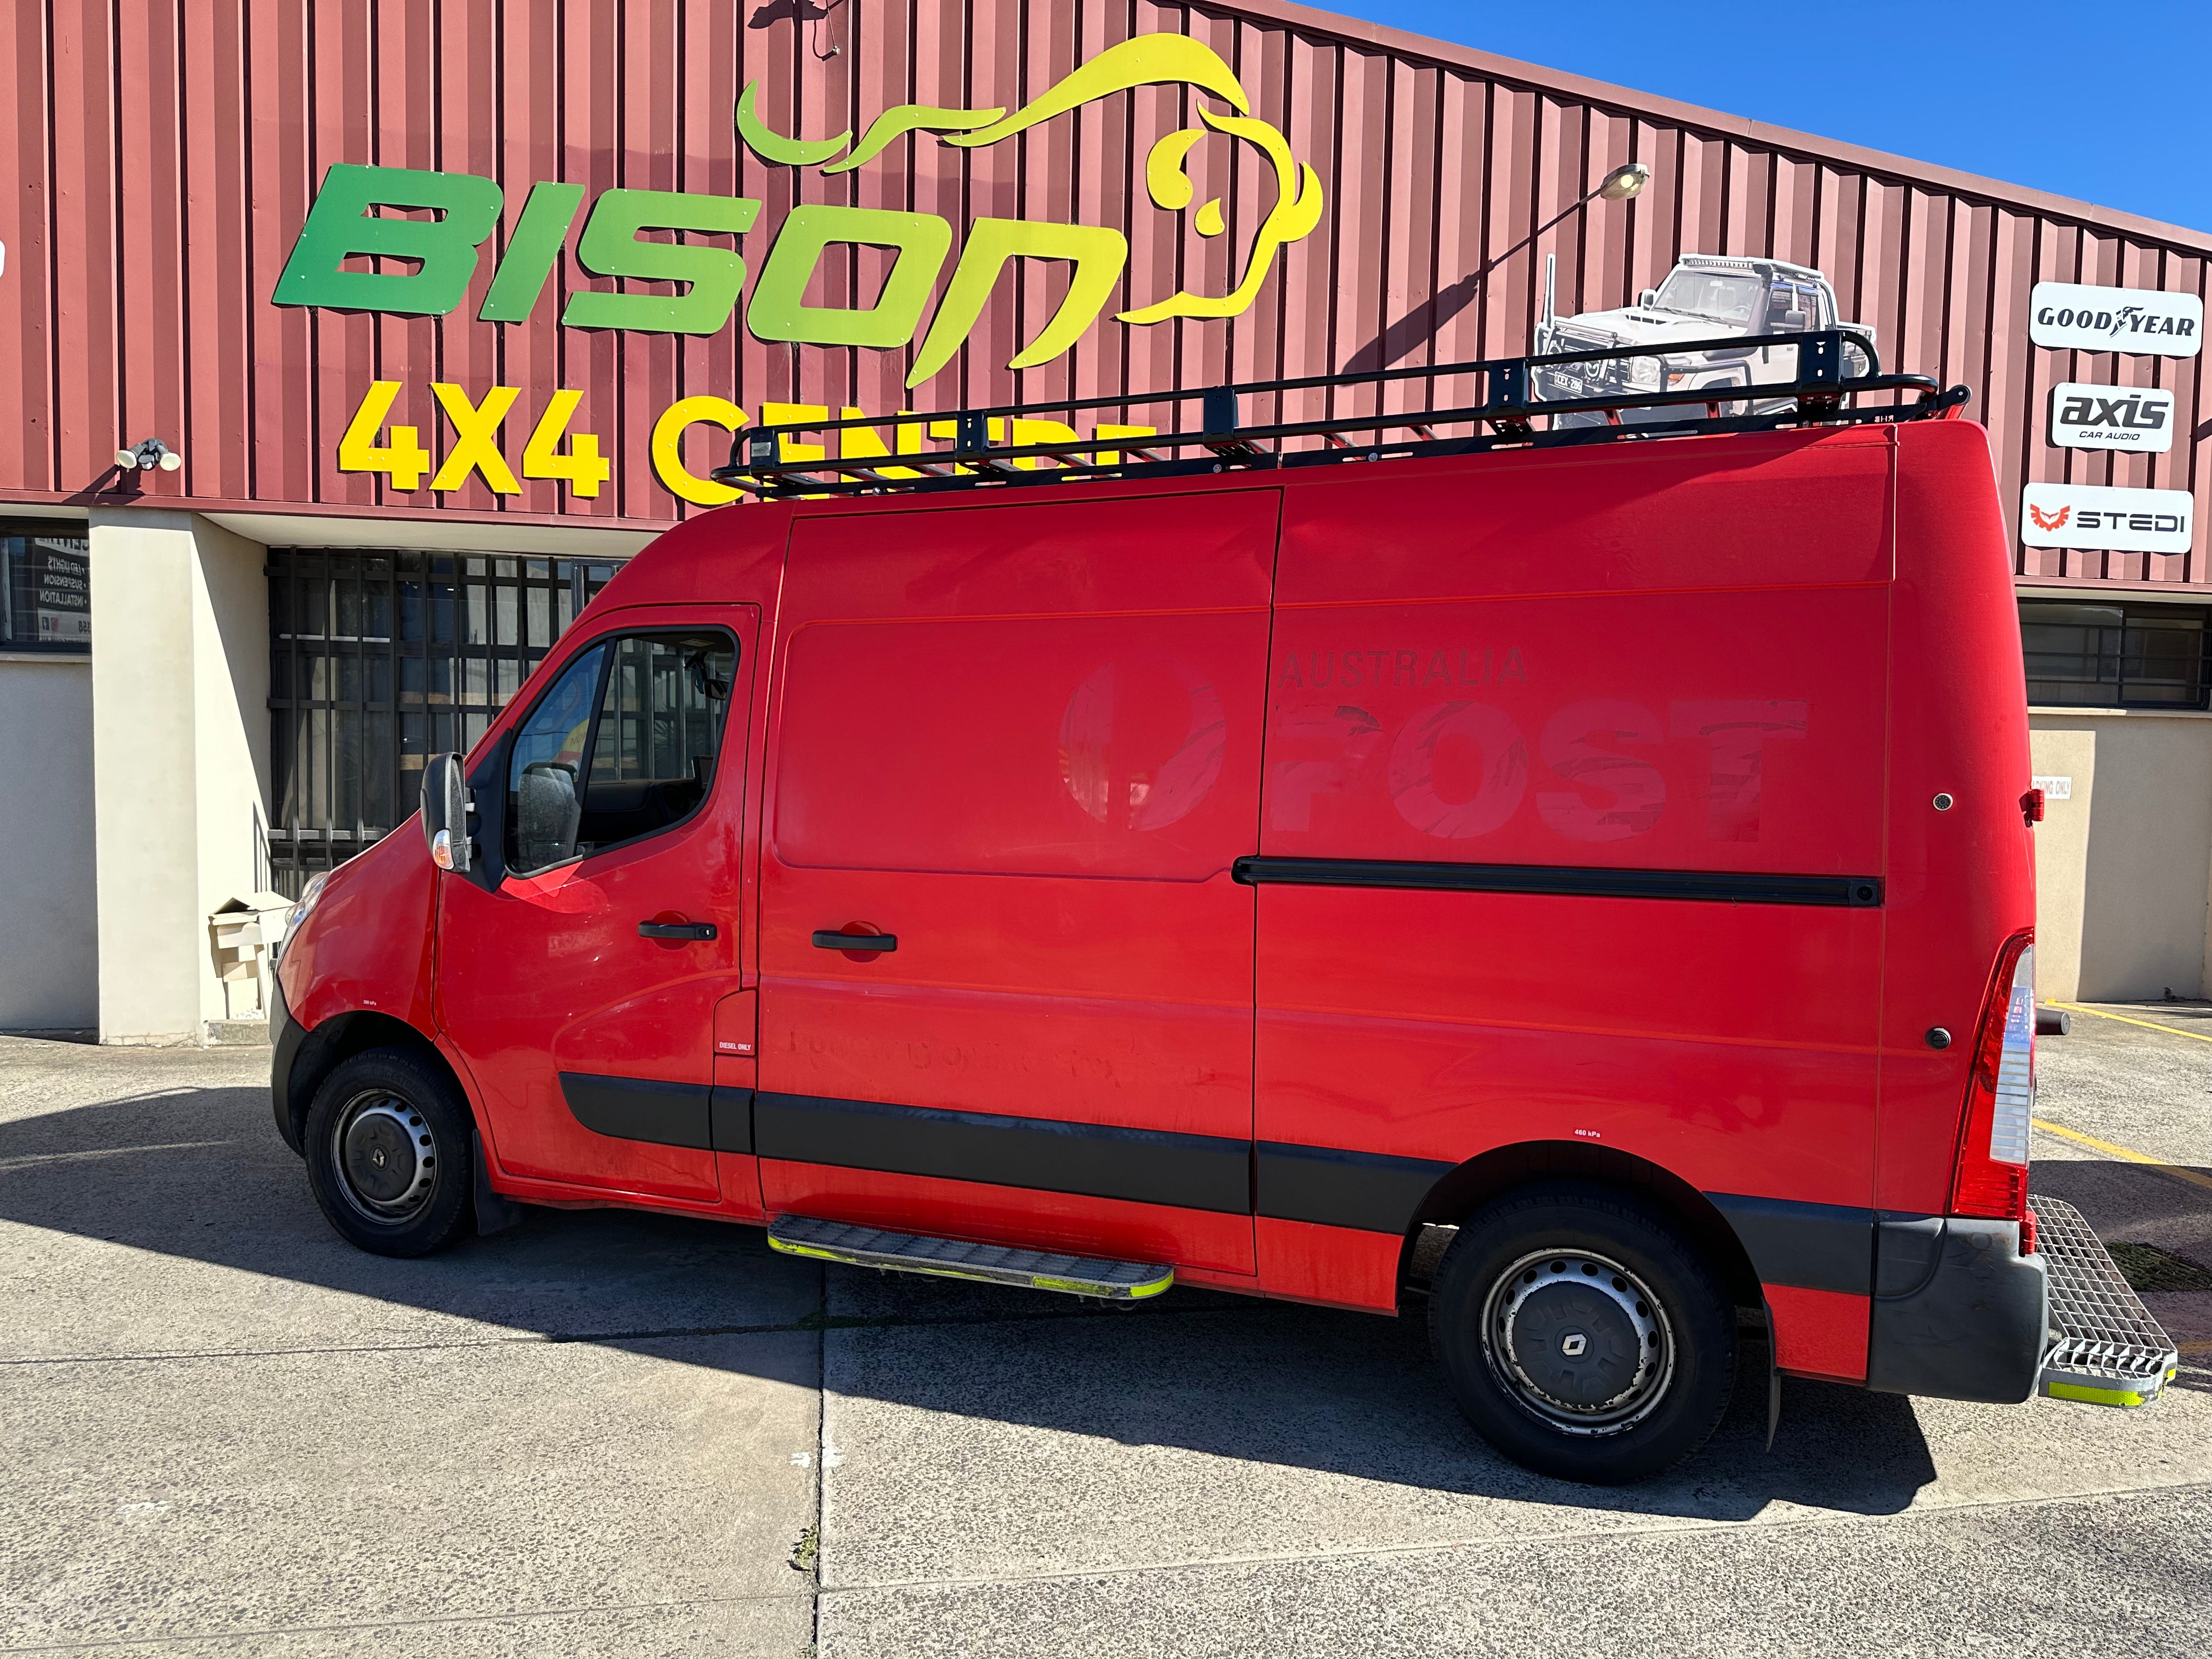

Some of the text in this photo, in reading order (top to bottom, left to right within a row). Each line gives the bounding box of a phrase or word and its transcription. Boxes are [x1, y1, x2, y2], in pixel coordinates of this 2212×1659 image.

[2060, 394, 2169, 430] axis
[338, 381, 610, 497] 4X4
[2079, 431, 2141, 441] CAR AUDIO
[2077, 511, 2185, 533] STEDI
[1277, 647, 1528, 689] AUSTRALIA
[1271, 699, 1808, 842] POST
[2056, 781, 2070, 794] ONLY
